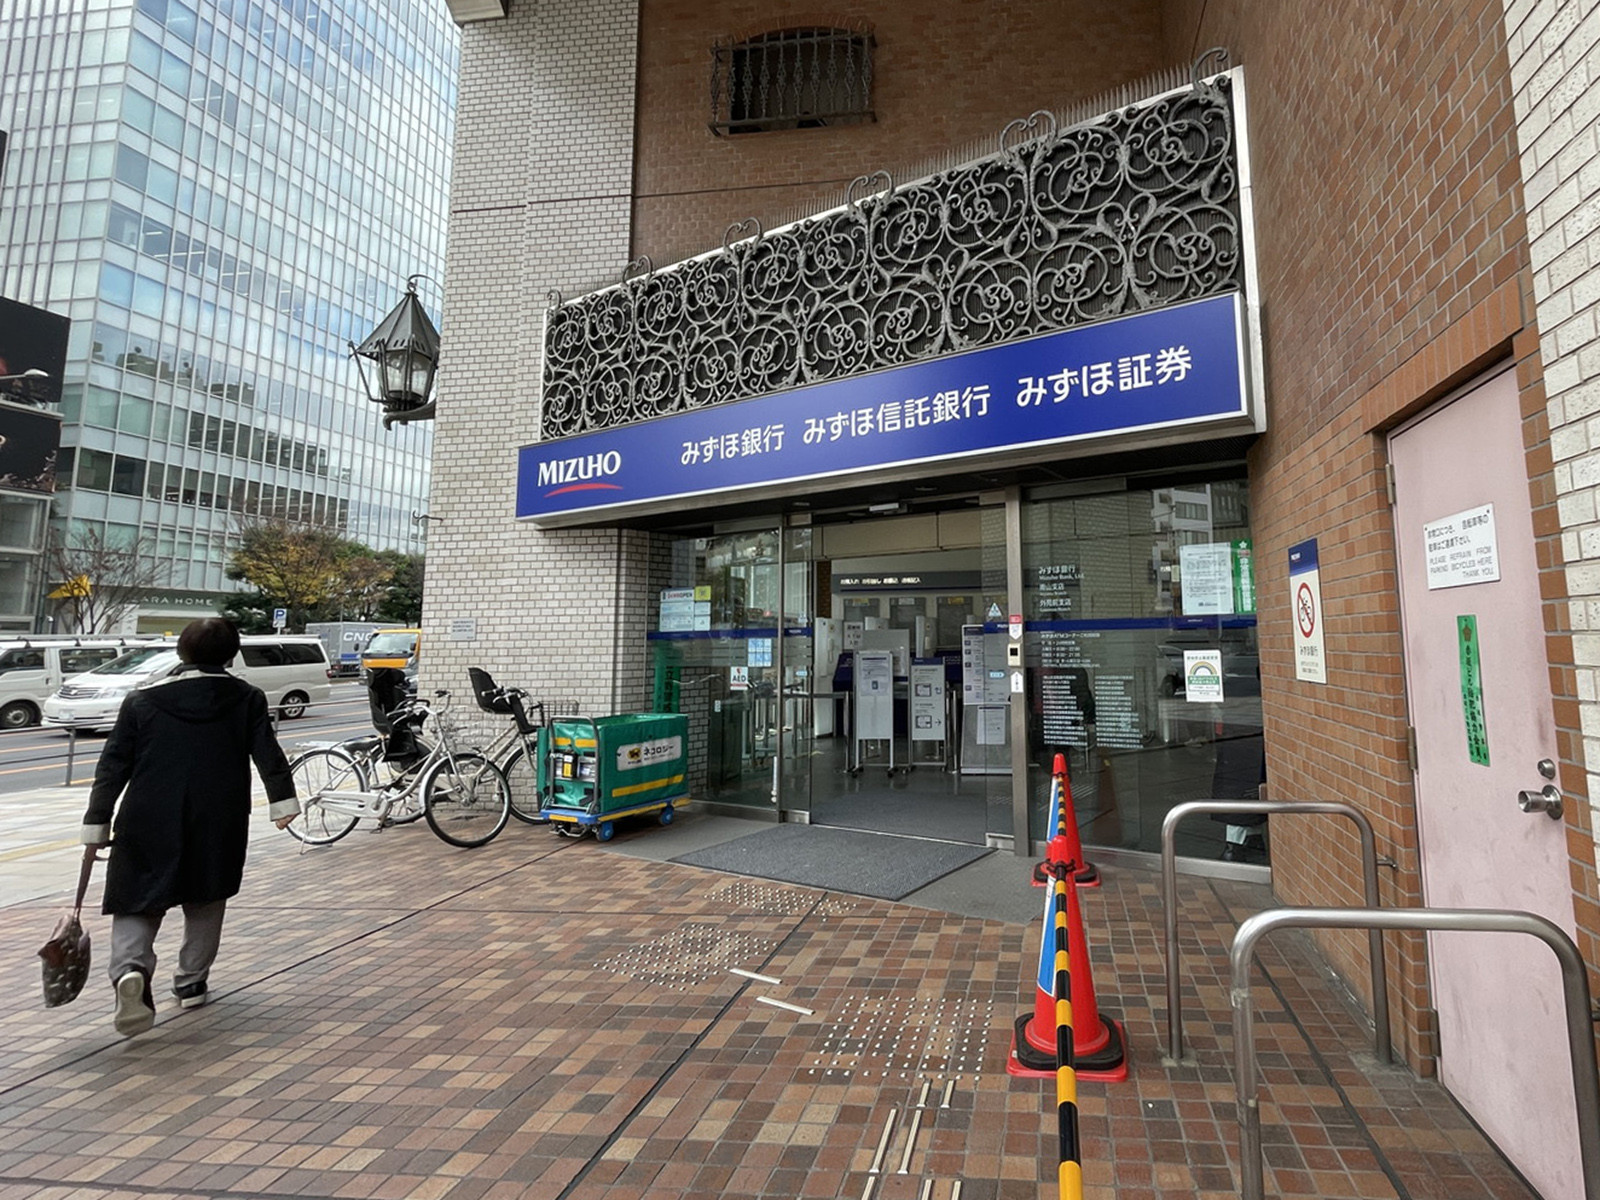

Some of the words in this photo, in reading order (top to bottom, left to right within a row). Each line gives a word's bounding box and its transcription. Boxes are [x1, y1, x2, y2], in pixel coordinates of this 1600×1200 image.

[680, 423, 785, 466] みずほ銀行
[803, 385, 991, 444] みずほ信託銀行
[1016, 346, 1193, 408] みずほ証券
[537, 450, 621, 487] MIZUHO
[1476, 546, 1492, 555] FROM
[1477, 556, 1492, 566] HERE
[1482, 567, 1494, 575] YOU
[175, 597, 214, 606] HOME
[732, 675, 747, 683] AED
[643, 745, 674, 756] ネコロジー
